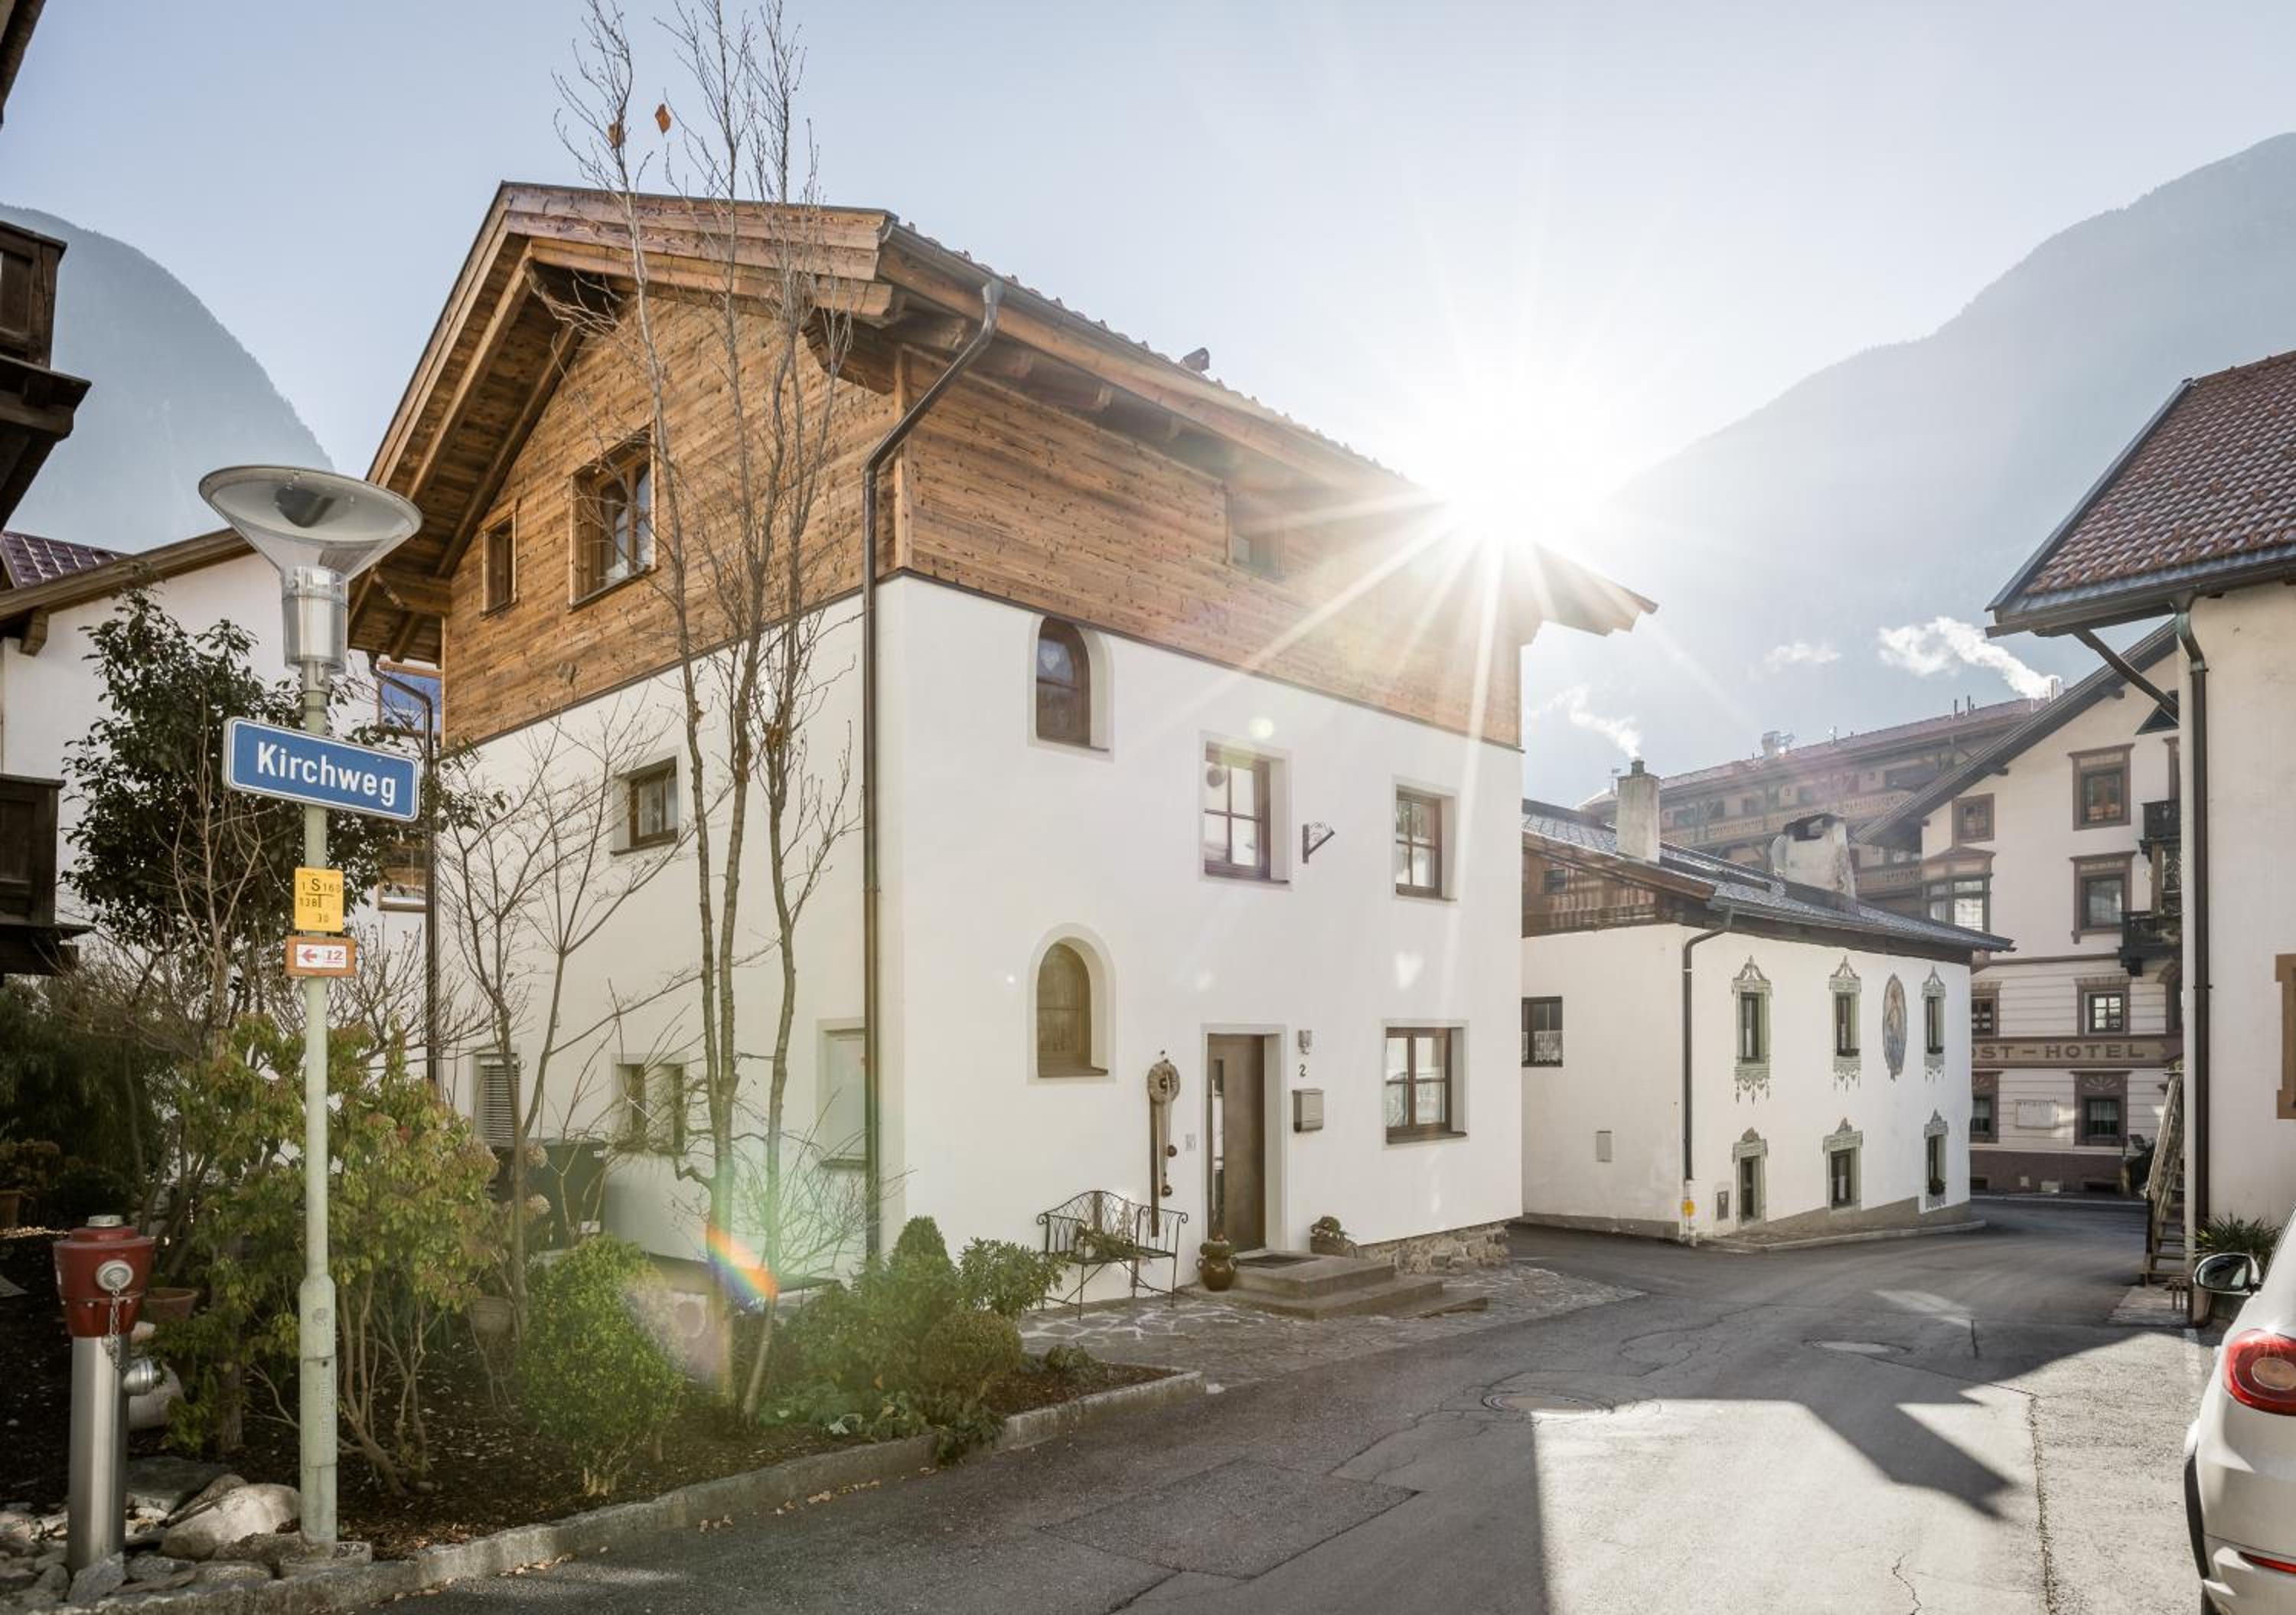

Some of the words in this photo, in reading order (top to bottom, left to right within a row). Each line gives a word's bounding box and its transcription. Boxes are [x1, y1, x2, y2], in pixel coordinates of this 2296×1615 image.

[257, 741, 396, 808] Kirchweg
[311, 878, 321, 892] S
[327, 950, 344, 961] 12
[2045, 1044, 2146, 1059] HOTEL
[1299, 1064, 1306, 1077] 2
